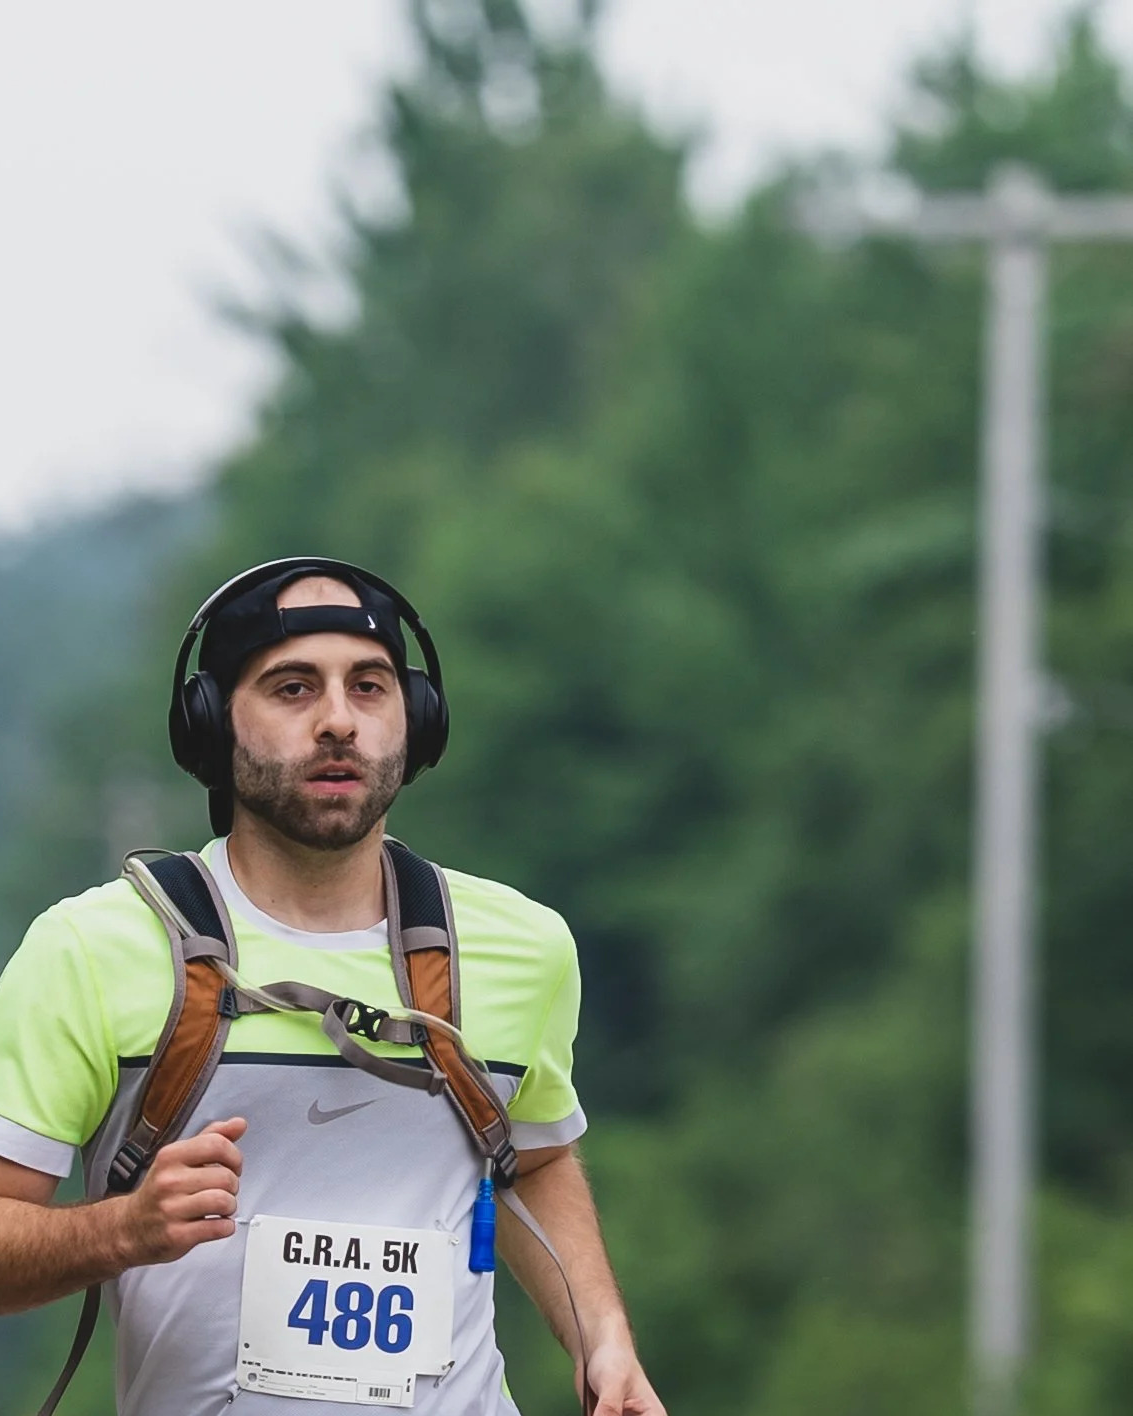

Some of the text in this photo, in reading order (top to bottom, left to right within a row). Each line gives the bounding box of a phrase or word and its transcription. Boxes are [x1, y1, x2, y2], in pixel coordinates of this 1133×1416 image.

[283, 1231, 419, 1274] G.R.A. 5K
[287, 1279, 414, 1354] 486
